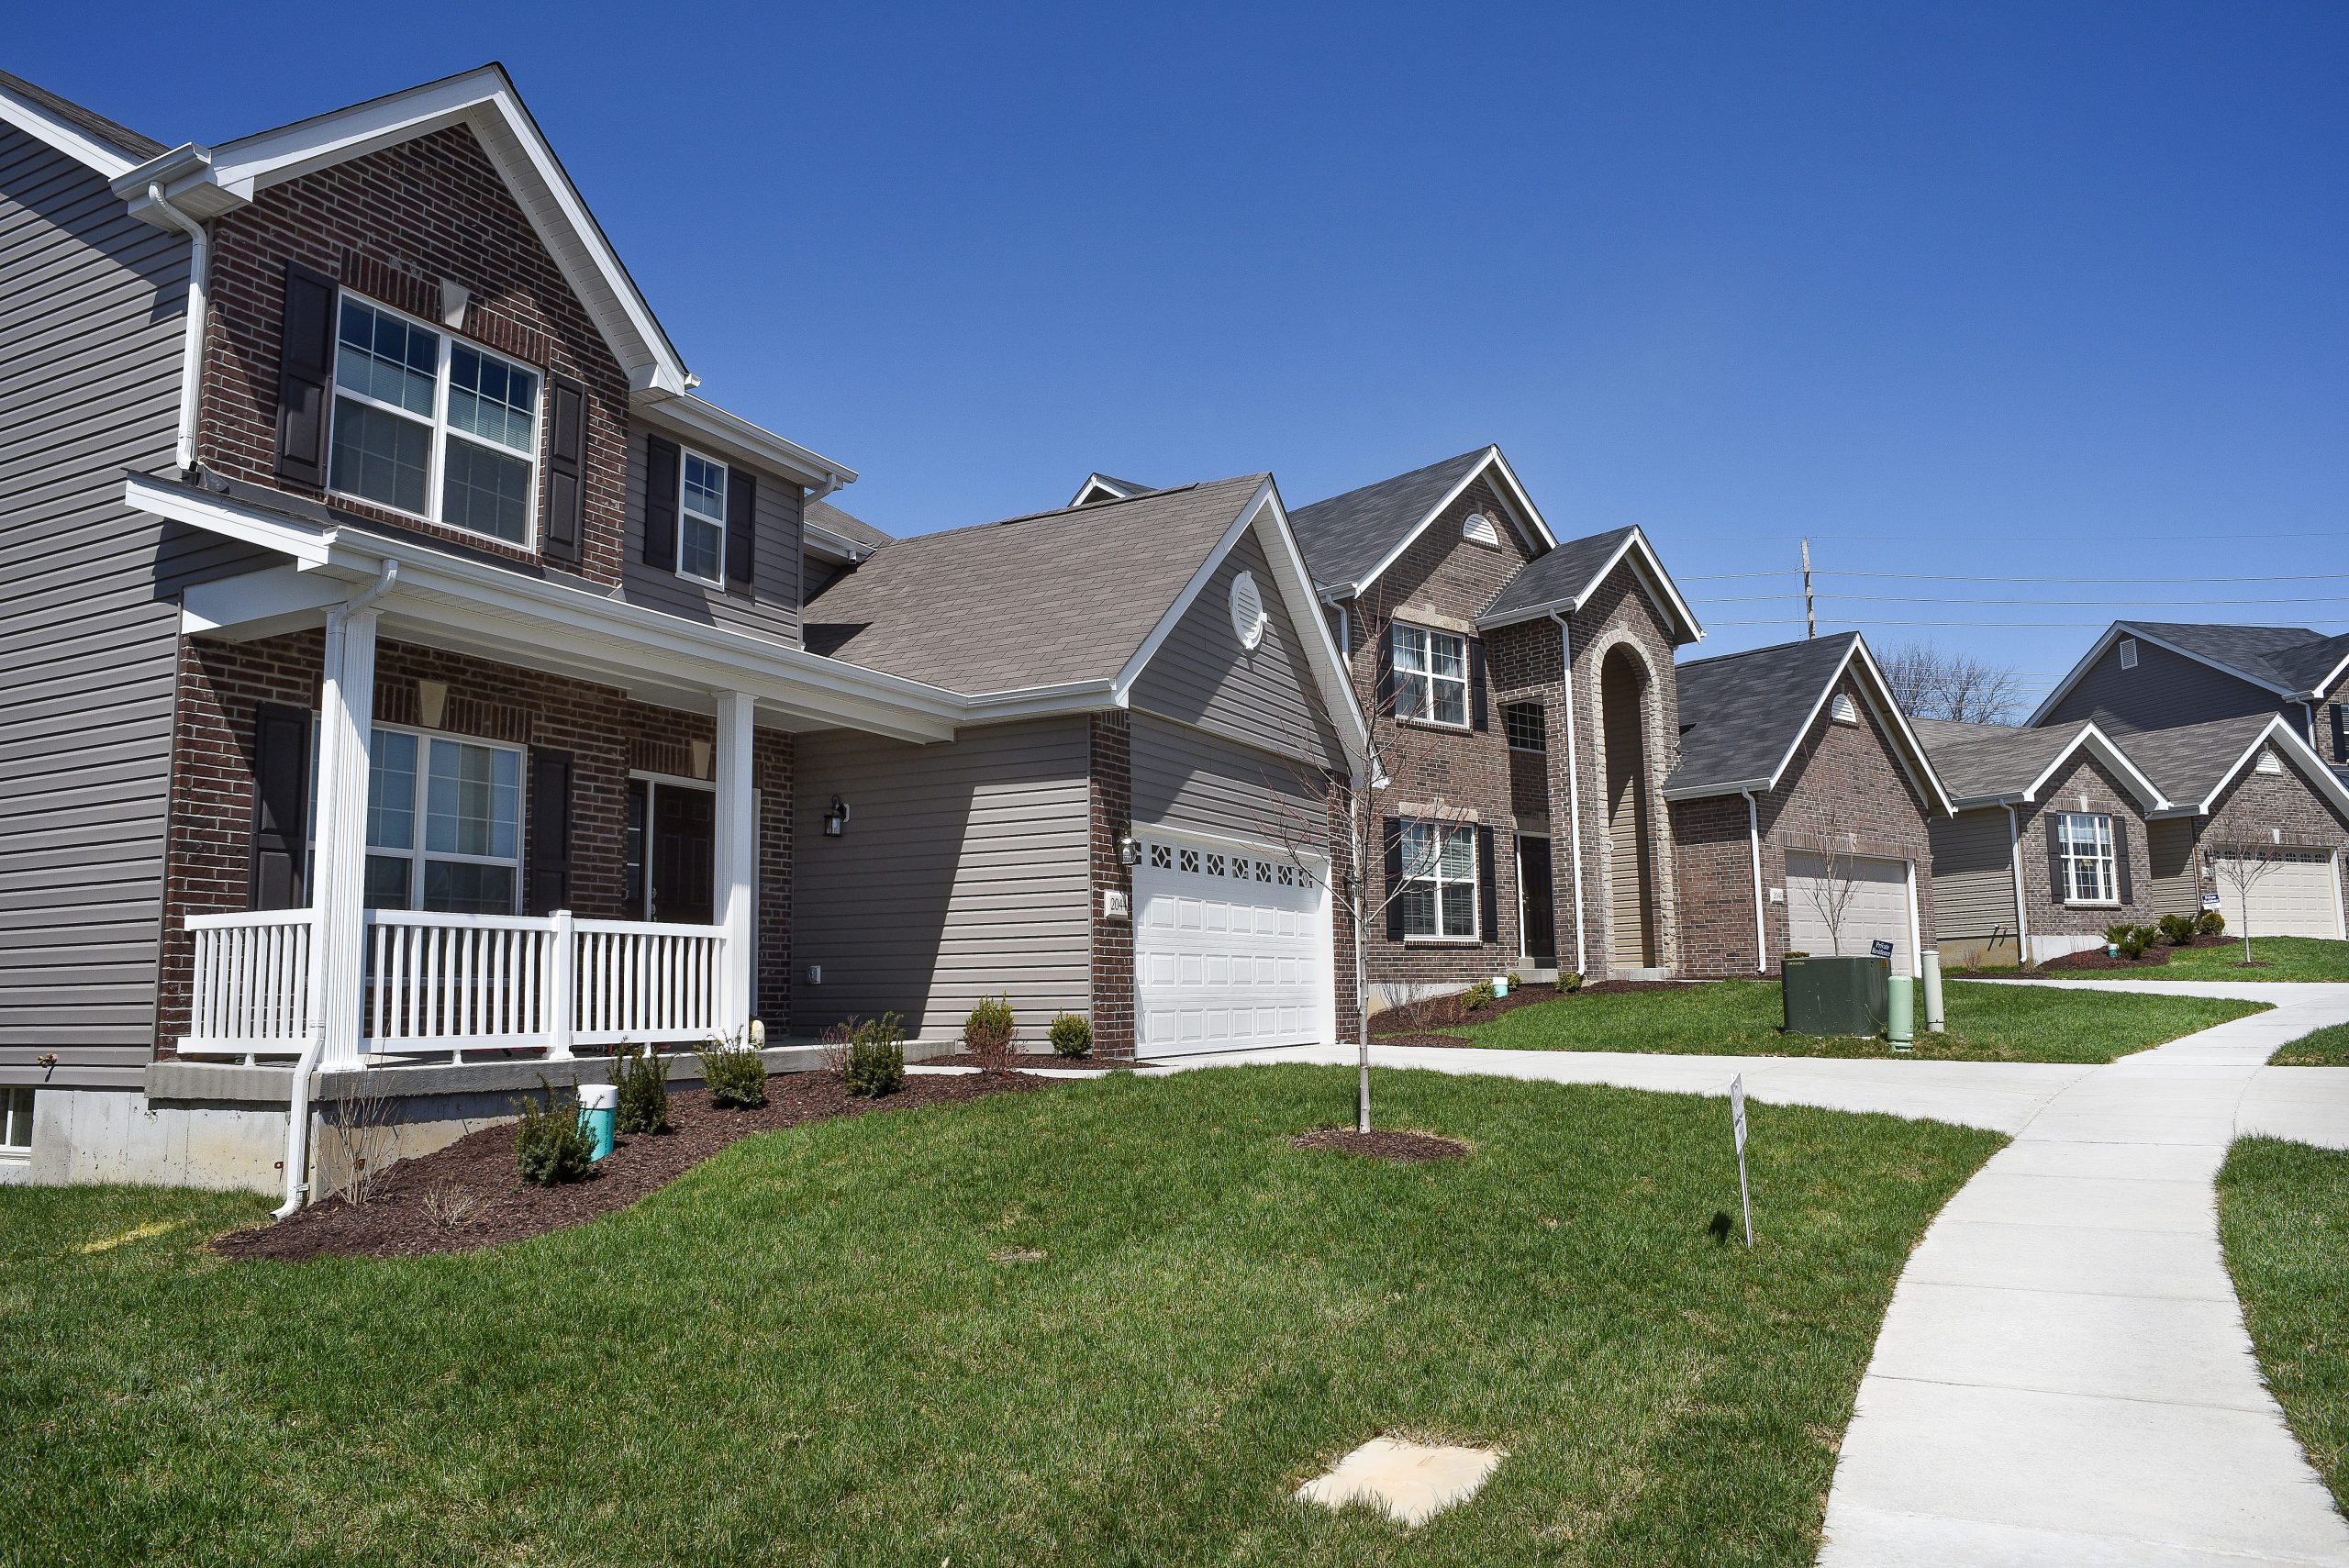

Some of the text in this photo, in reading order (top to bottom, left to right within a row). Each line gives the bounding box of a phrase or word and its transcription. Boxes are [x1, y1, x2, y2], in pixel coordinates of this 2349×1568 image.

[1111, 898, 1127, 911] 2044
[1876, 941, 1890, 950] Private
[1872, 947, 1890, 956] Residence
